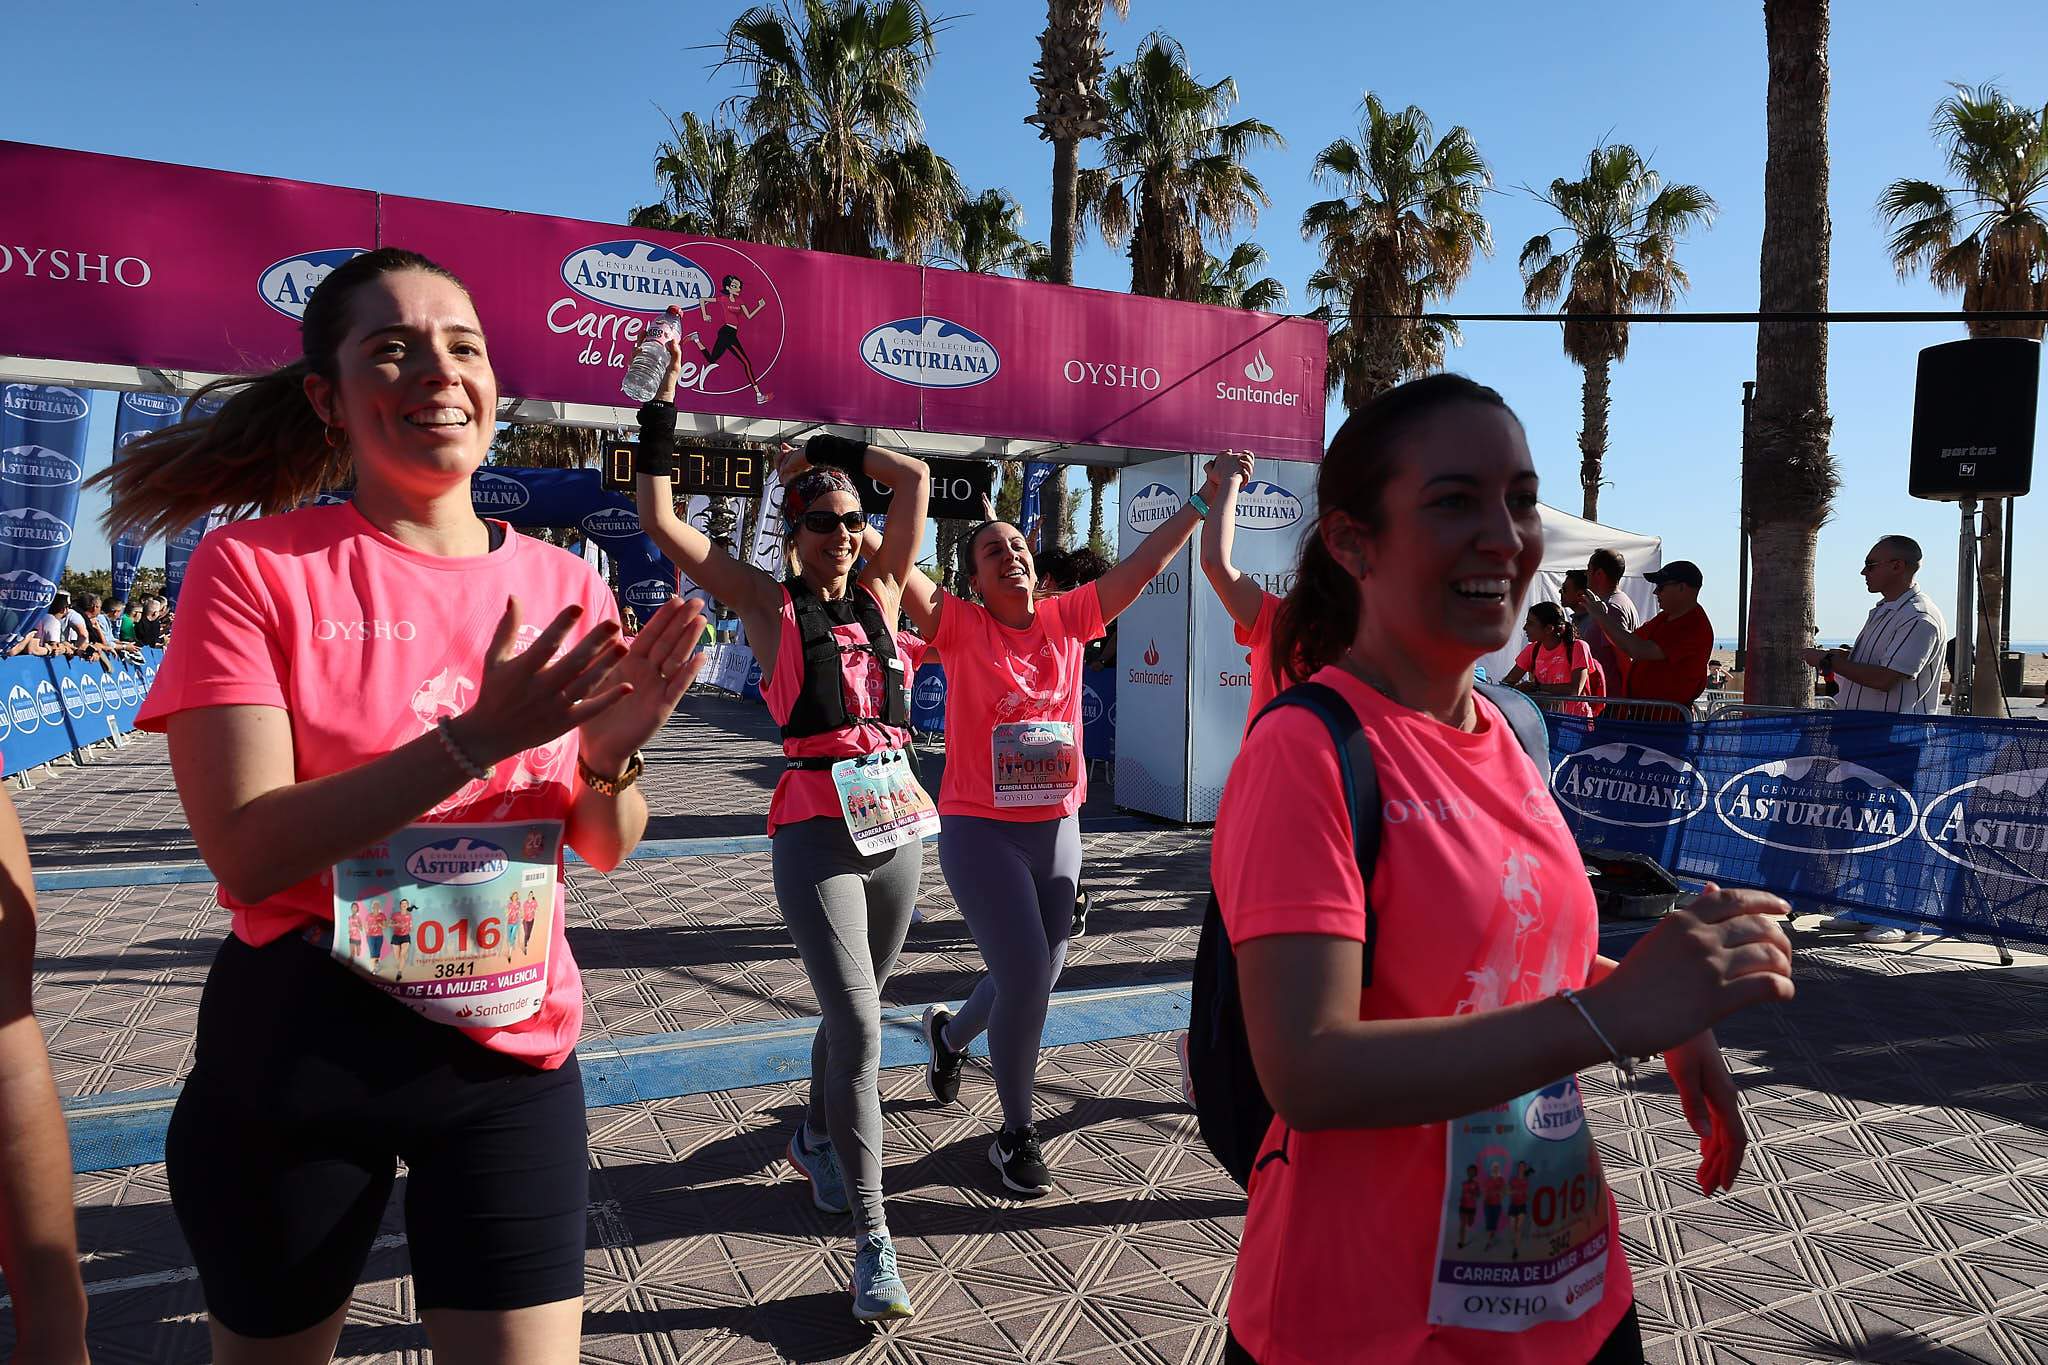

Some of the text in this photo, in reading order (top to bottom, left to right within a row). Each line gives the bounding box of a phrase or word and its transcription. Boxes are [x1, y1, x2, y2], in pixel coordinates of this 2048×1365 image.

[573, 258, 701, 300] ASTURIANA
[597, 260, 699, 279] CENTRAL LECHERA
[578, 339, 625, 369] de la
[871, 337, 990, 374] ASTURIANA
[893, 338, 986, 353] CENTRAL LECHERA
[1063, 360, 1161, 391] OYSHO
[4, 391, 80, 416] ASTURIANA
[129, 393, 176, 412] ASTURIANA
[1216, 382, 1299, 407] Santander
[472, 490, 522, 504] RIANA
[1131, 504, 1176, 524] ASTURIANA
[1235, 505, 1297, 520] STURIANA
[0, 526, 65, 544] STURIANA
[588, 519, 640, 531] ASTURIAN
[315, 619, 417, 641] OYSHO
[1128, 668, 1174, 686] Santander
[1023, 760, 1056, 773] 016
[1560, 762, 1692, 811] ASTURIANA
[1640, 772, 1692, 786] LECHERA
[1761, 784, 1897, 804] CENTRAL LECHERA
[1726, 783, 1898, 836] ASTURIANA
[413, 854, 504, 875] ASTURIANA
[416, 917, 501, 955] 016
[434, 961, 475, 979] 3841
[407, 985, 423, 996] DE
[426, 984, 443, 996] LA
[446, 979, 488, 994] MUJER
[497, 967, 538, 989] VALENCIA
[474, 996, 530, 1018] Santander
[1532, 1173, 1586, 1228] 016
[1453, 1265, 1520, 1283] CARRERA
[1523, 1265, 1541, 1282] DE
[1543, 1261, 1557, 1279] LA
[1463, 1295, 1547, 1316] OYSHO
